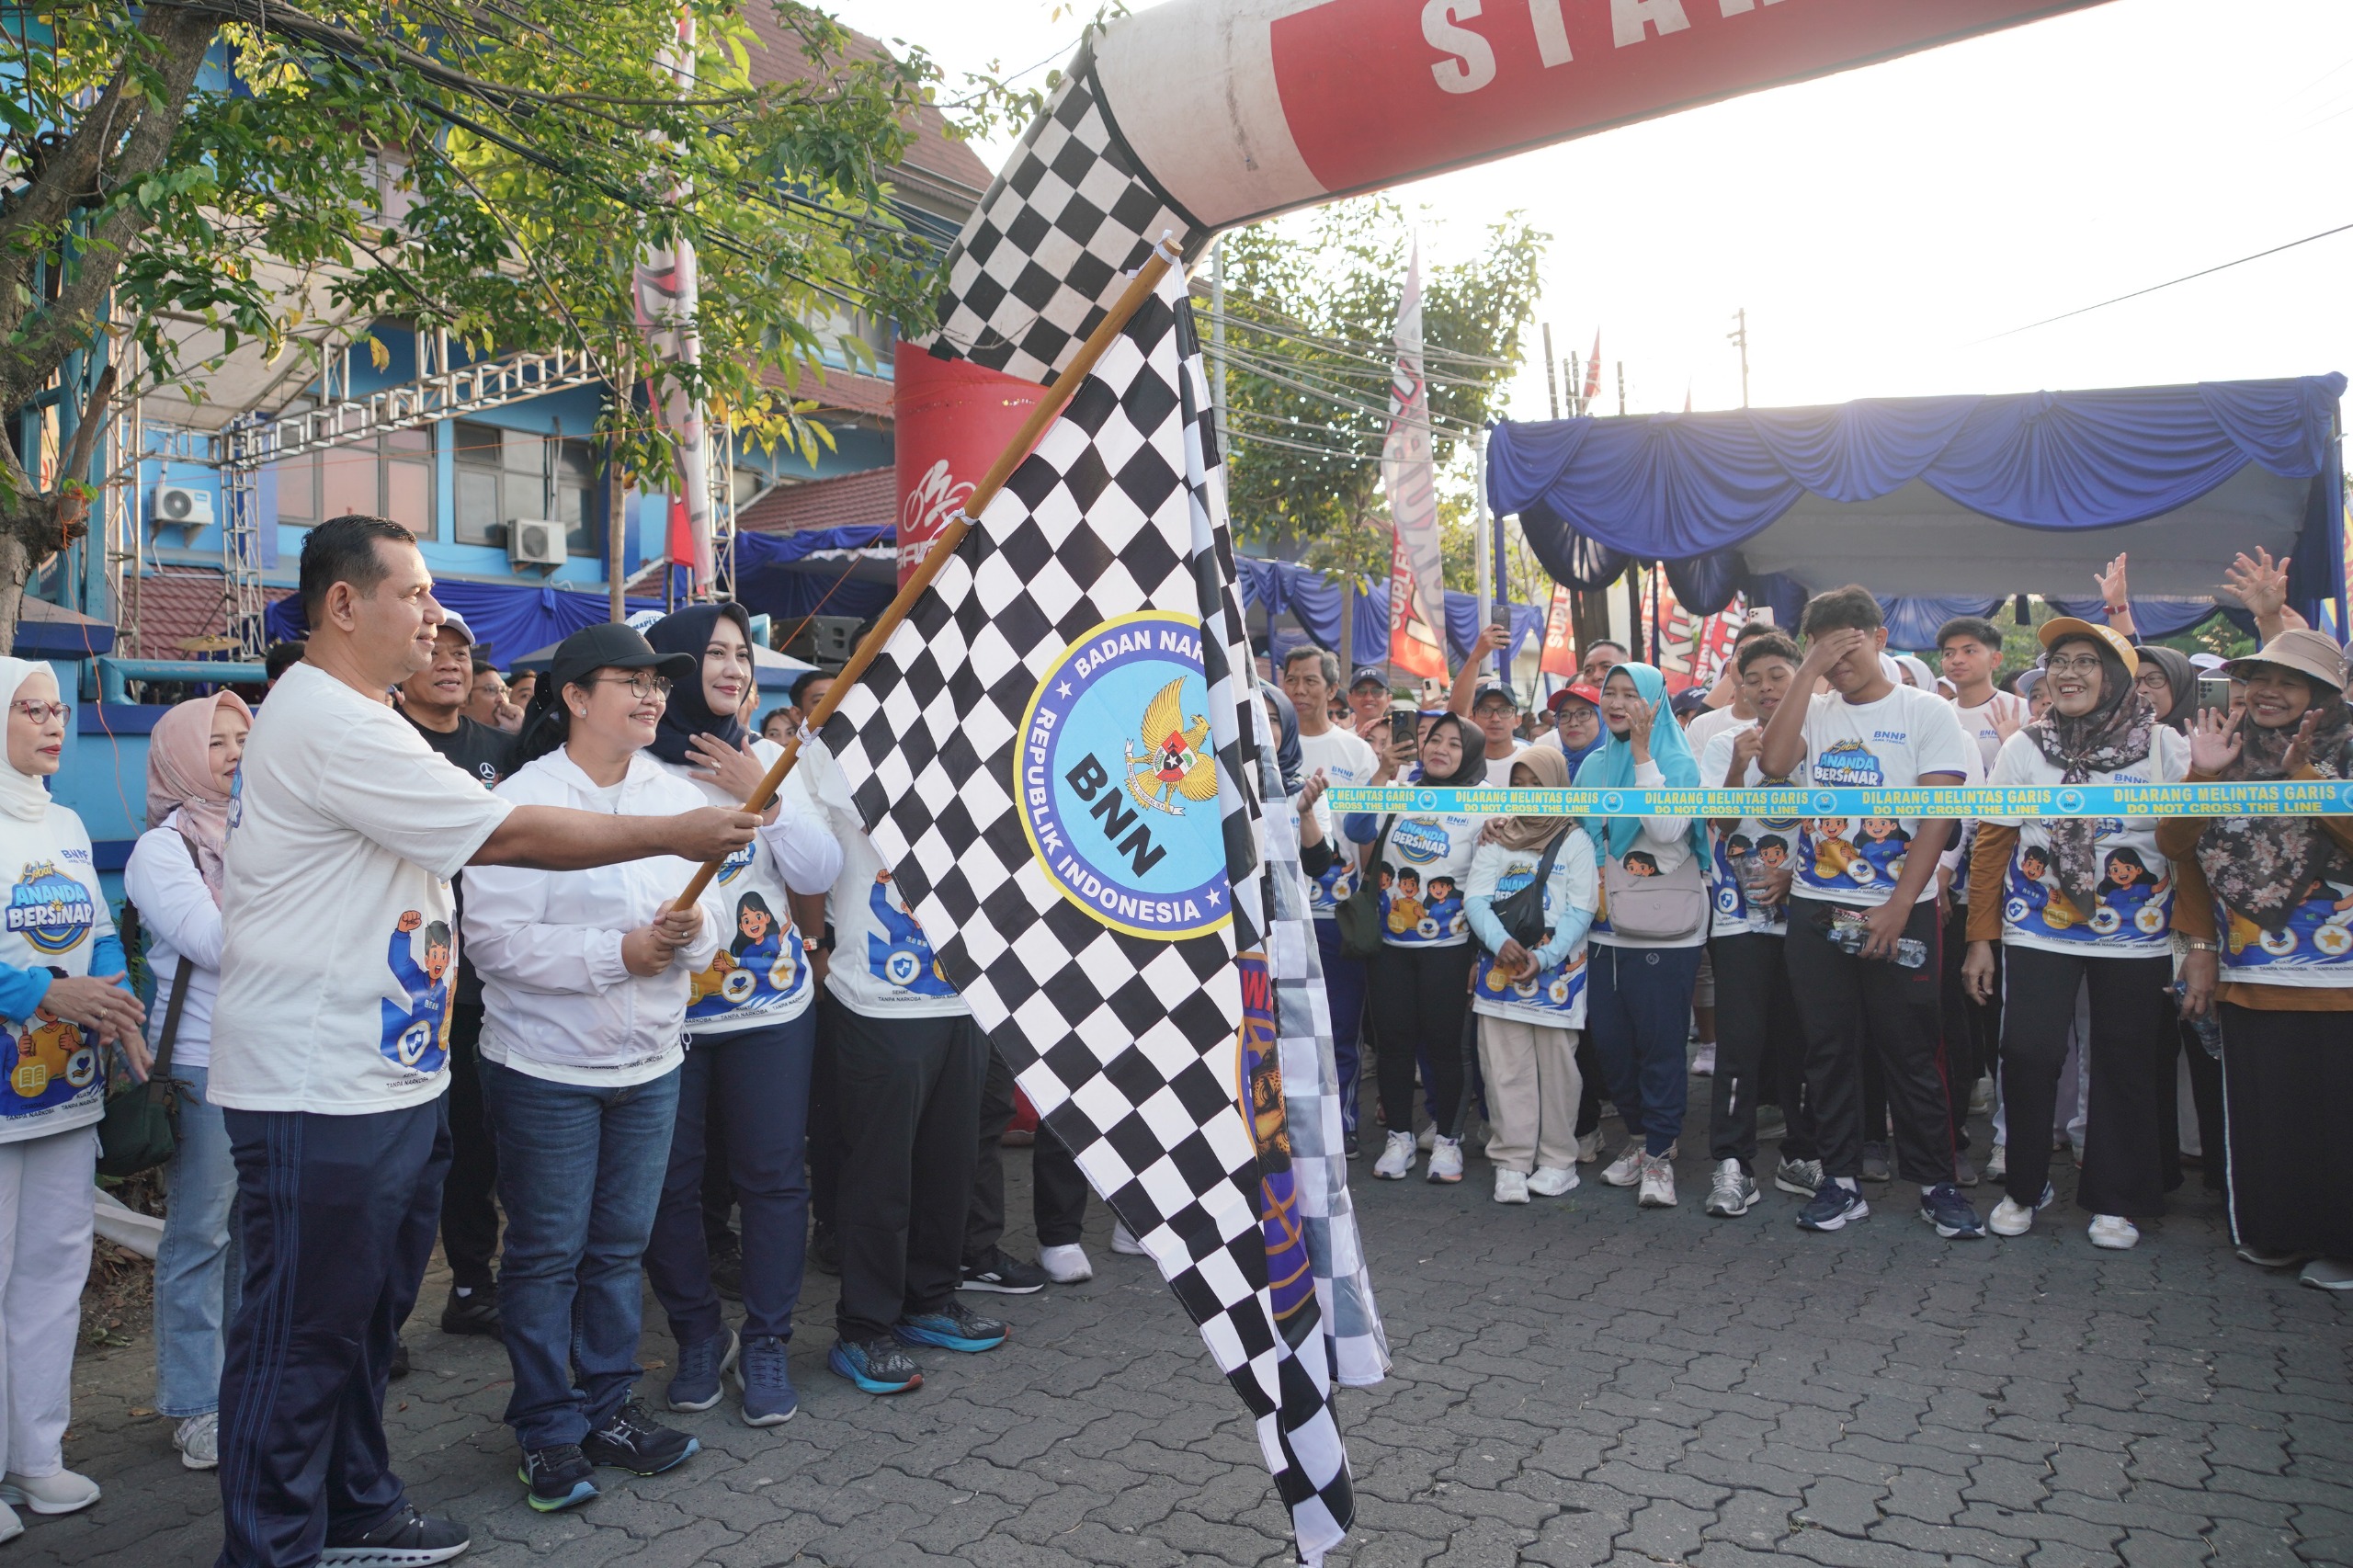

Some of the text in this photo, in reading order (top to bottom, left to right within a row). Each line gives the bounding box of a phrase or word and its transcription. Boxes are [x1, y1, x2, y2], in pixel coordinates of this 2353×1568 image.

[1074, 630, 1152, 679] BADAN
[1873, 731, 1906, 741] BNNP
[1821, 754, 1875, 770] ANANDA
[1337, 790, 1383, 801] MELINTAS
[1385, 790, 1415, 802] GARIS
[1455, 790, 1598, 804] DILARANG MELINTAS GARIS
[1645, 791, 1809, 804] DILARANG MELINTAS GARIS
[1862, 790, 2052, 804] DILARANG MELINTAS GARIS
[2114, 785, 2336, 802] DILARANG MELINTAS GARIS
[1332, 801, 1363, 810] CROSS
[1385, 802, 1408, 811] LINE
[1505, 804, 1540, 812] CROSS
[1655, 806, 1799, 814] DO NOT CROSS THE LINE
[1873, 805, 2040, 815] DO NOT CROSS THE LINE
[2127, 802, 2323, 813] DO NOT CROSS THE LINE
[1027, 707, 1202, 923] REPUBLIK INDONESIA
[1064, 752, 1167, 879] BNN
[1399, 822, 1446, 843] ANANDA
[22, 858, 55, 885] Sobat
[16, 884, 87, 907] ANANDA
[740, 1008, 768, 1017] NARKOBA
[772, 1002, 789, 1010] TANPA
[386, 1076, 428, 1089] TANPA NARKOBA
[6, 1108, 55, 1122] TANPA NARKOBA
